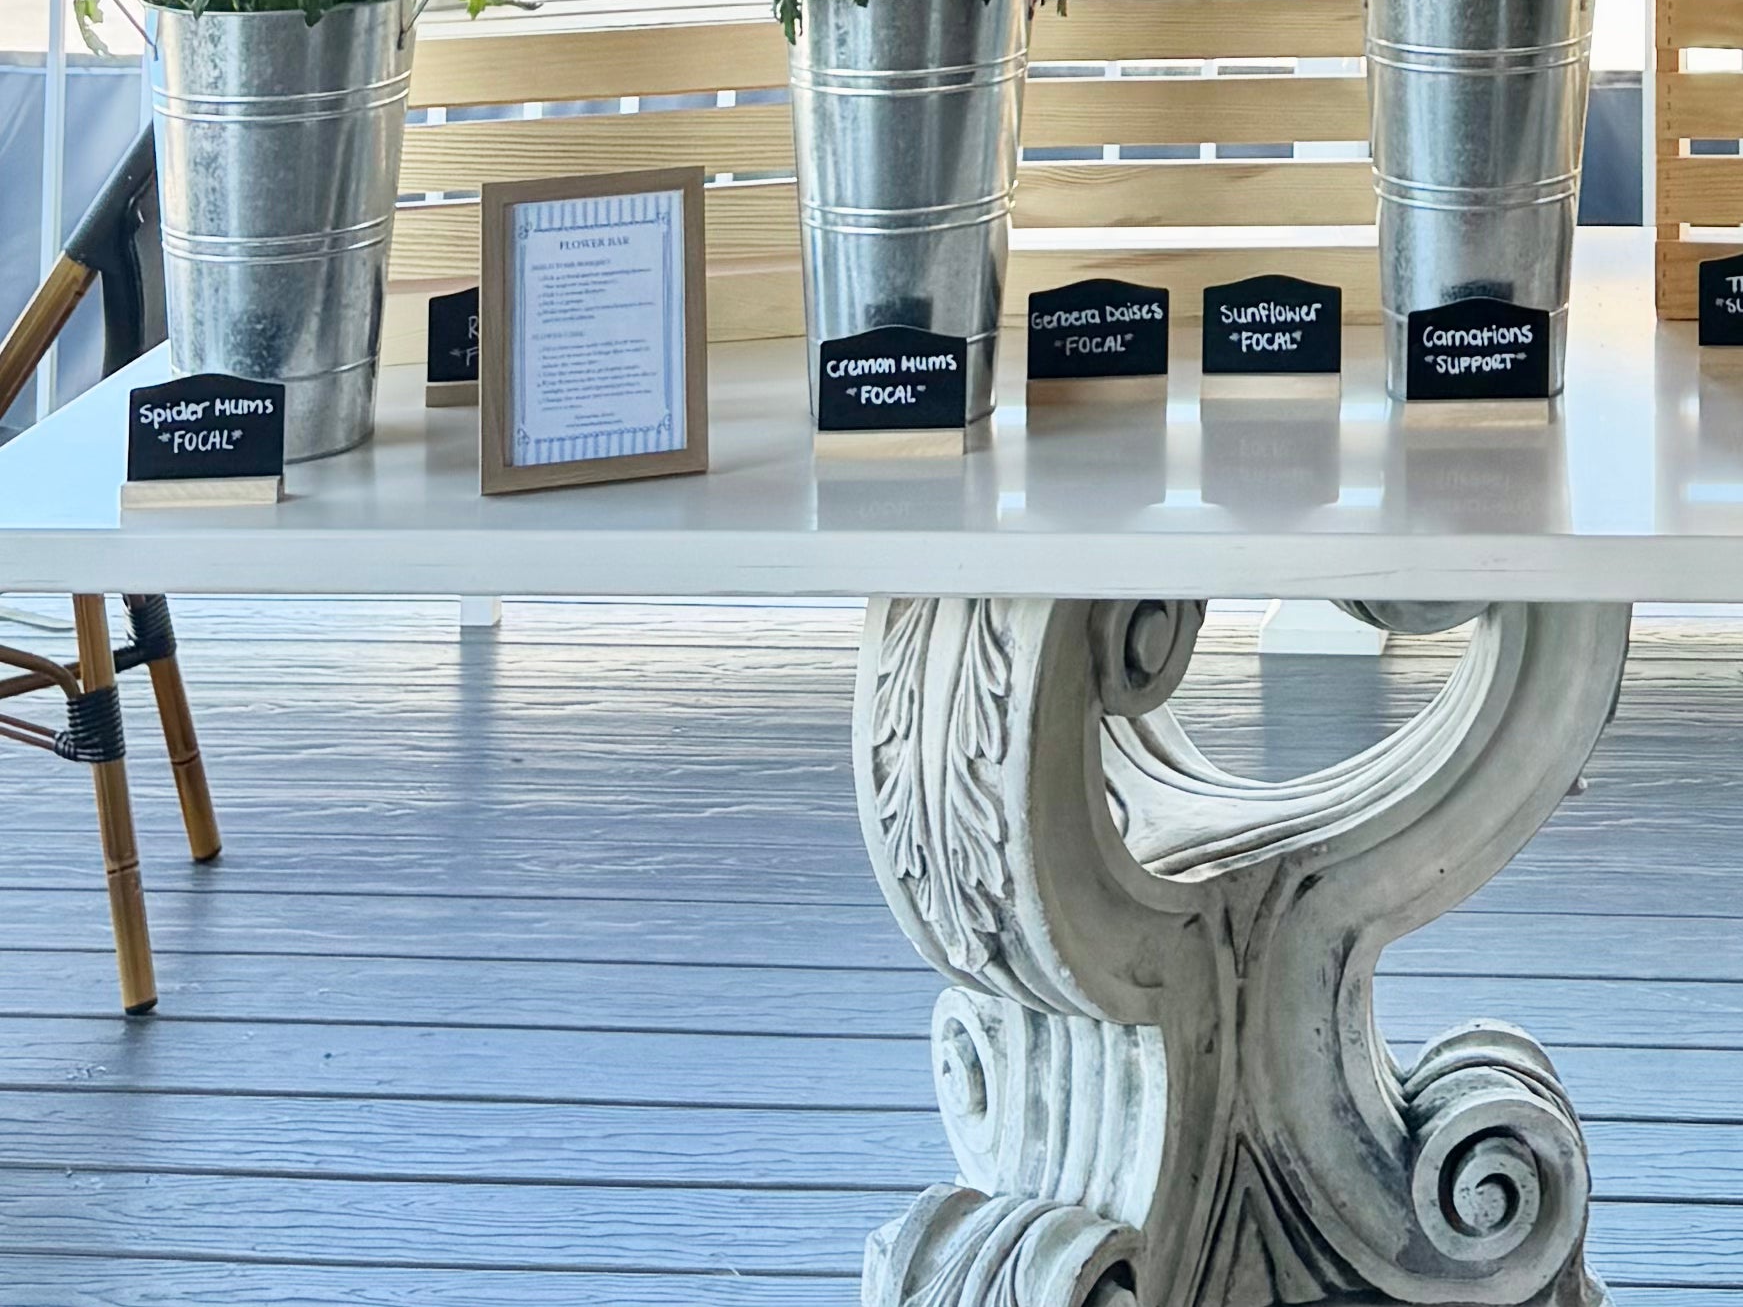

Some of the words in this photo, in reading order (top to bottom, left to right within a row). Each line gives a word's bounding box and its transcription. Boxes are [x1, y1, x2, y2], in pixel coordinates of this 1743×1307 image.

[1220, 301, 1322, 325] Sunflower
[1422, 324, 1533, 348] Carnations
[826, 357, 896, 378] Cremon
[901, 354, 957, 373] Mums
[139, 401, 210, 430] Spider
[214, 398, 274, 417] Mums
